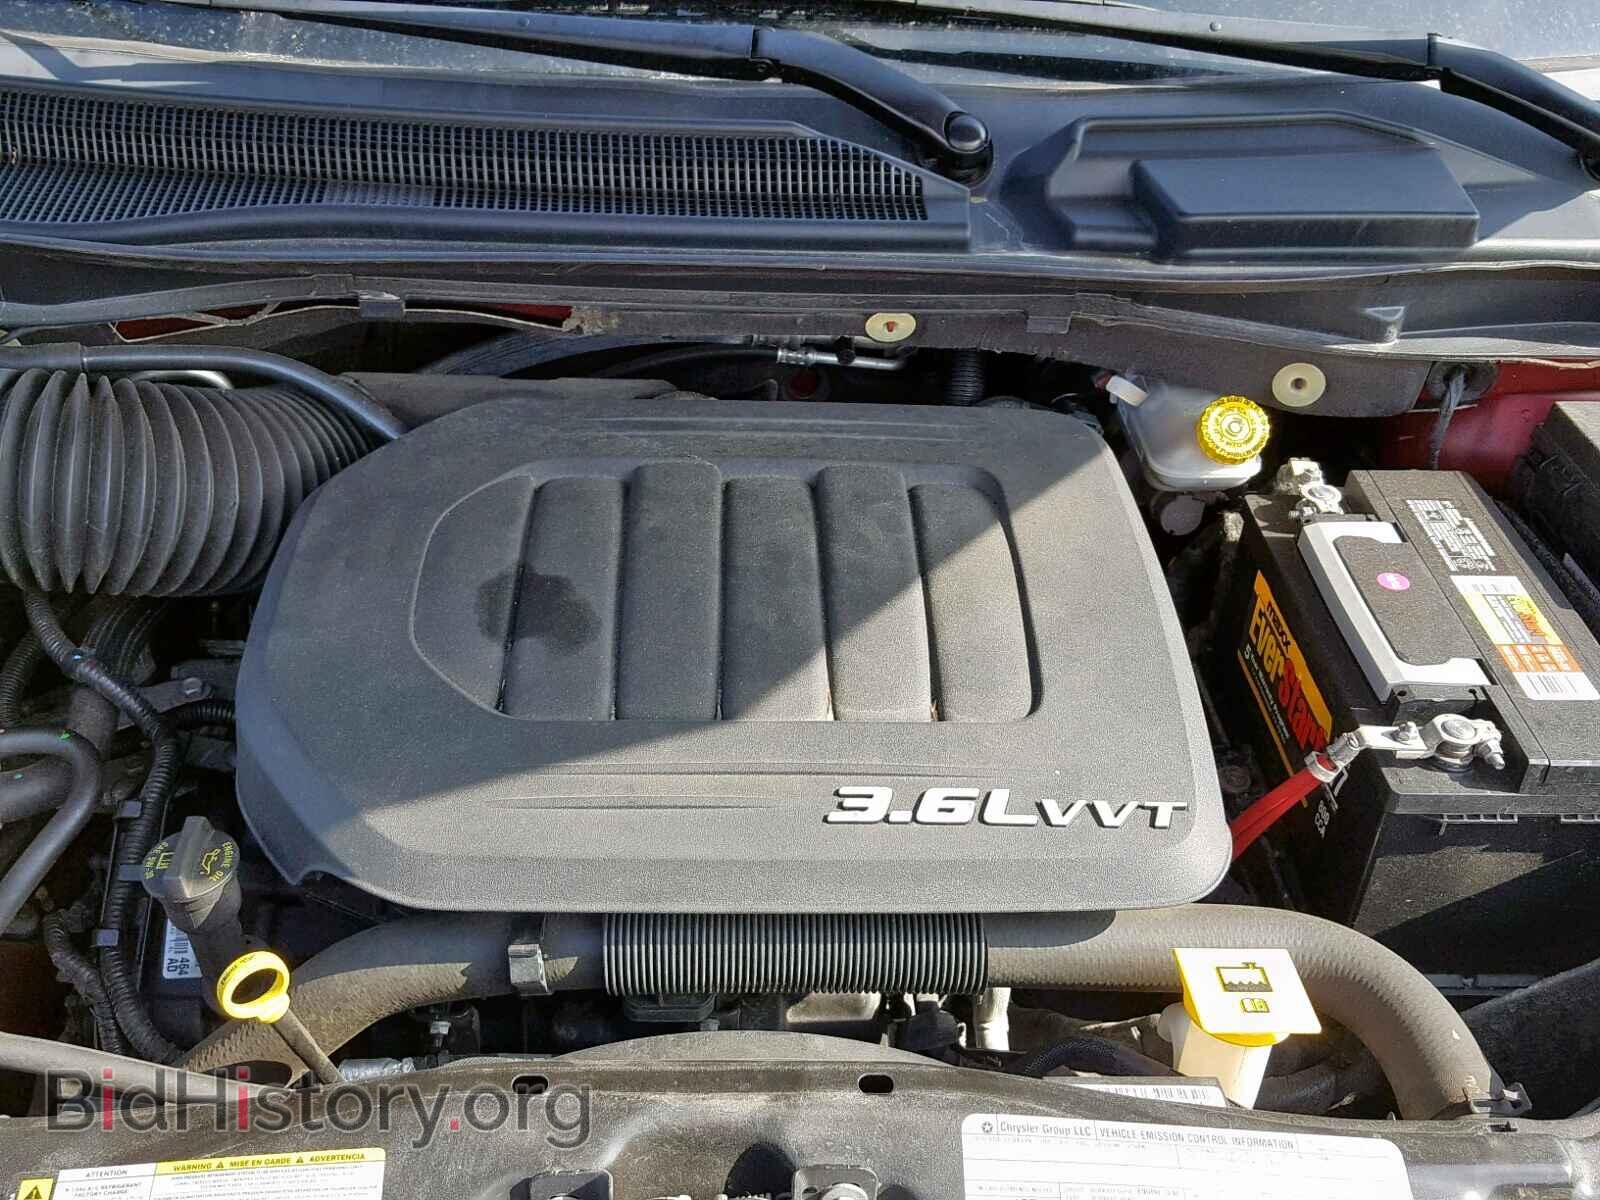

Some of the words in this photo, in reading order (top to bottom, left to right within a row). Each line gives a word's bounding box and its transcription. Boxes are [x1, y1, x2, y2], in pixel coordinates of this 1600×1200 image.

[1000, 1120, 1039, 1134] Chrysler
[1042, 1123, 1071, 1137] Group
[1073, 1126, 1091, 1137] LLC
[1099, 1127, 1136, 1140] VEHICLE
[1139, 1129, 1185, 1143] EMISSION
[1186, 1132, 1228, 1145] CONTROL
[1231, 1134, 1295, 1150] INFORMATION
[173, 1162, 213, 1172] WARNING
[251, 1158, 263, 1167] EN
[264, 1157, 292, 1166] GARDE
[309, 1153, 366, 1163] ADVERTENCIA
[85, 1169, 128, 1178] ATTENTION
